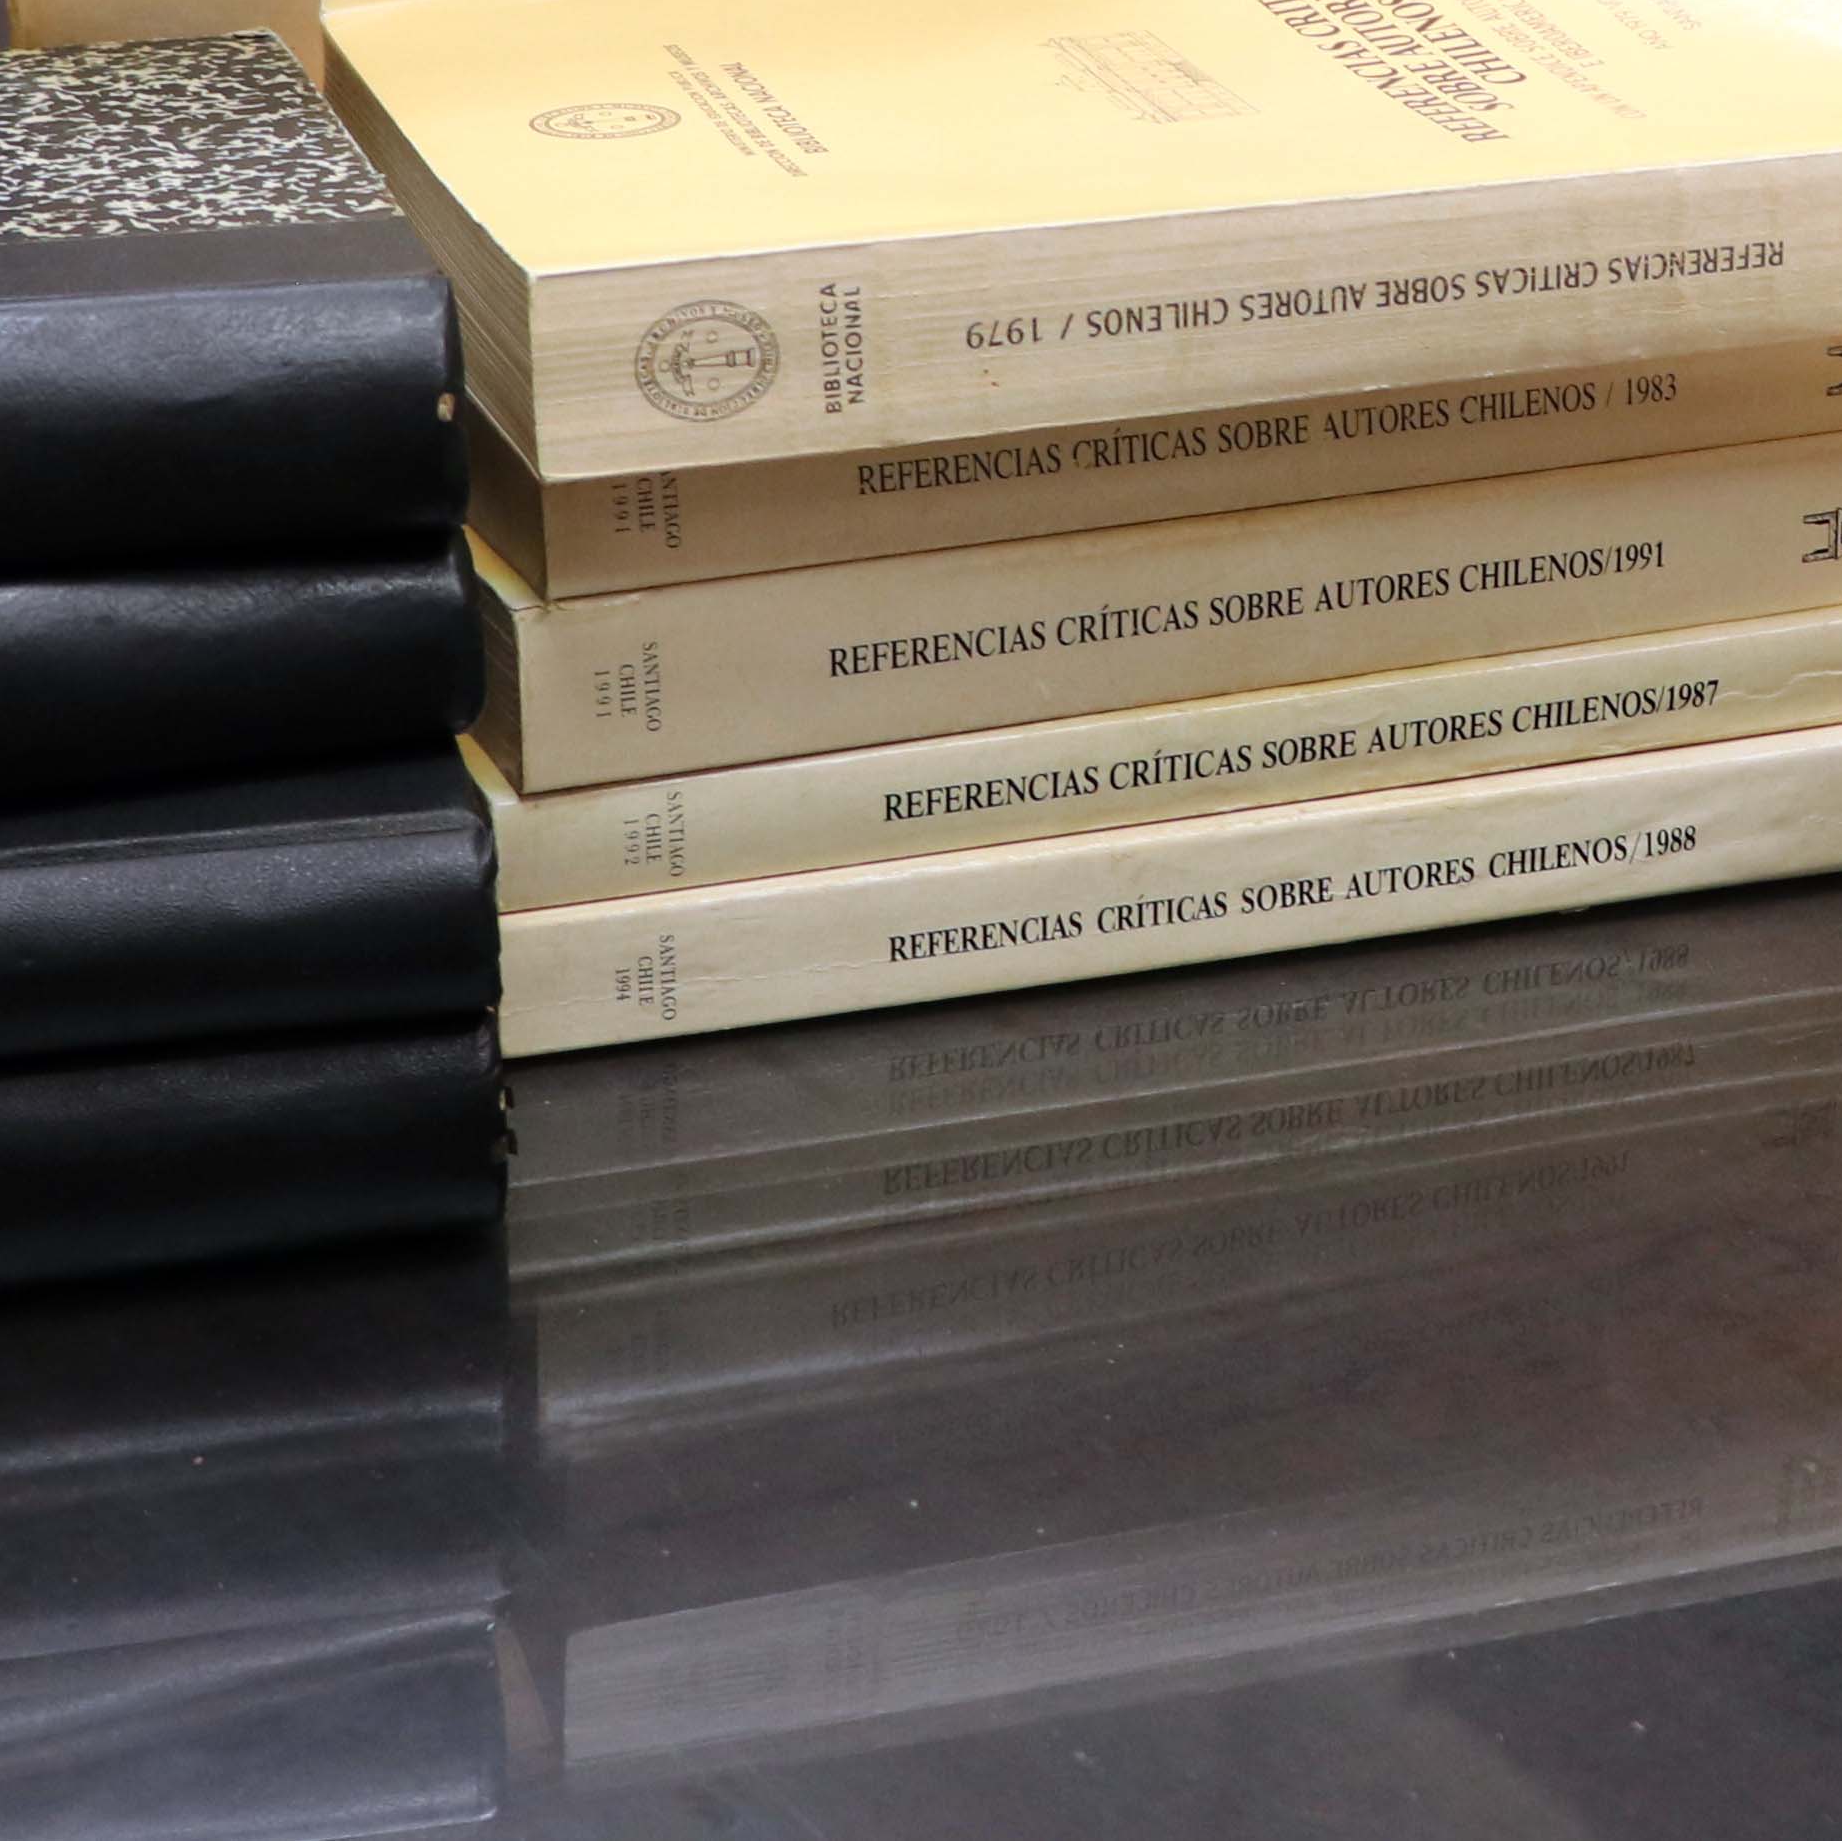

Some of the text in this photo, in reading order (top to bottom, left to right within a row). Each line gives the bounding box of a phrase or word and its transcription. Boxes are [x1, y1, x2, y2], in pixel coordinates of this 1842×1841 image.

[1492, 24, 1545, 53] SOBRE
[719, 62, 829, 154] BIBLIOTECA NACIONAL
[1318, 40, 1509, 142] REFERENCIAS
[1404, 59, 1515, 111] SOBRE
[965, 239, 1784, 349] REFERENCIAS CRITICAS SOBRE AUTORES CHILENOS / 1979
[820, 283, 842, 414] BIBLIOTECA
[844, 286, 864, 404] NACIONAL
[858, 372, 1677, 496] REFERENCIAS CRÍTICAS SOBRE AUTORES CHILENOS / 1983
[636, 478, 656, 533] CHILE
[829, 542, 1665, 678] REFERENCIAS CRÍTICAS SOBRE AUTORES CHILENOS/1991
[618, 664, 635, 718] CHILE
[641, 641, 662, 733] SANTIAGO
[883, 680, 1719, 822] REFERENCIAS CRÍTICAS SOBRE AUTORES CHILENOS/1987
[644, 813, 662, 865] CHILE
[666, 791, 684, 878] SANTIAGO
[888, 911, 1084, 962] REFERENCIAS
[1096, 891, 1228, 934] CRÍTICAS
[1241, 878, 1333, 916] SOBRE
[1344, 858, 1476, 900] AUTORES
[615, 968, 631, 1003] 1994
[637, 956, 654, 1006] CHILE
[660, 934, 676, 1021] SANTIAGO
